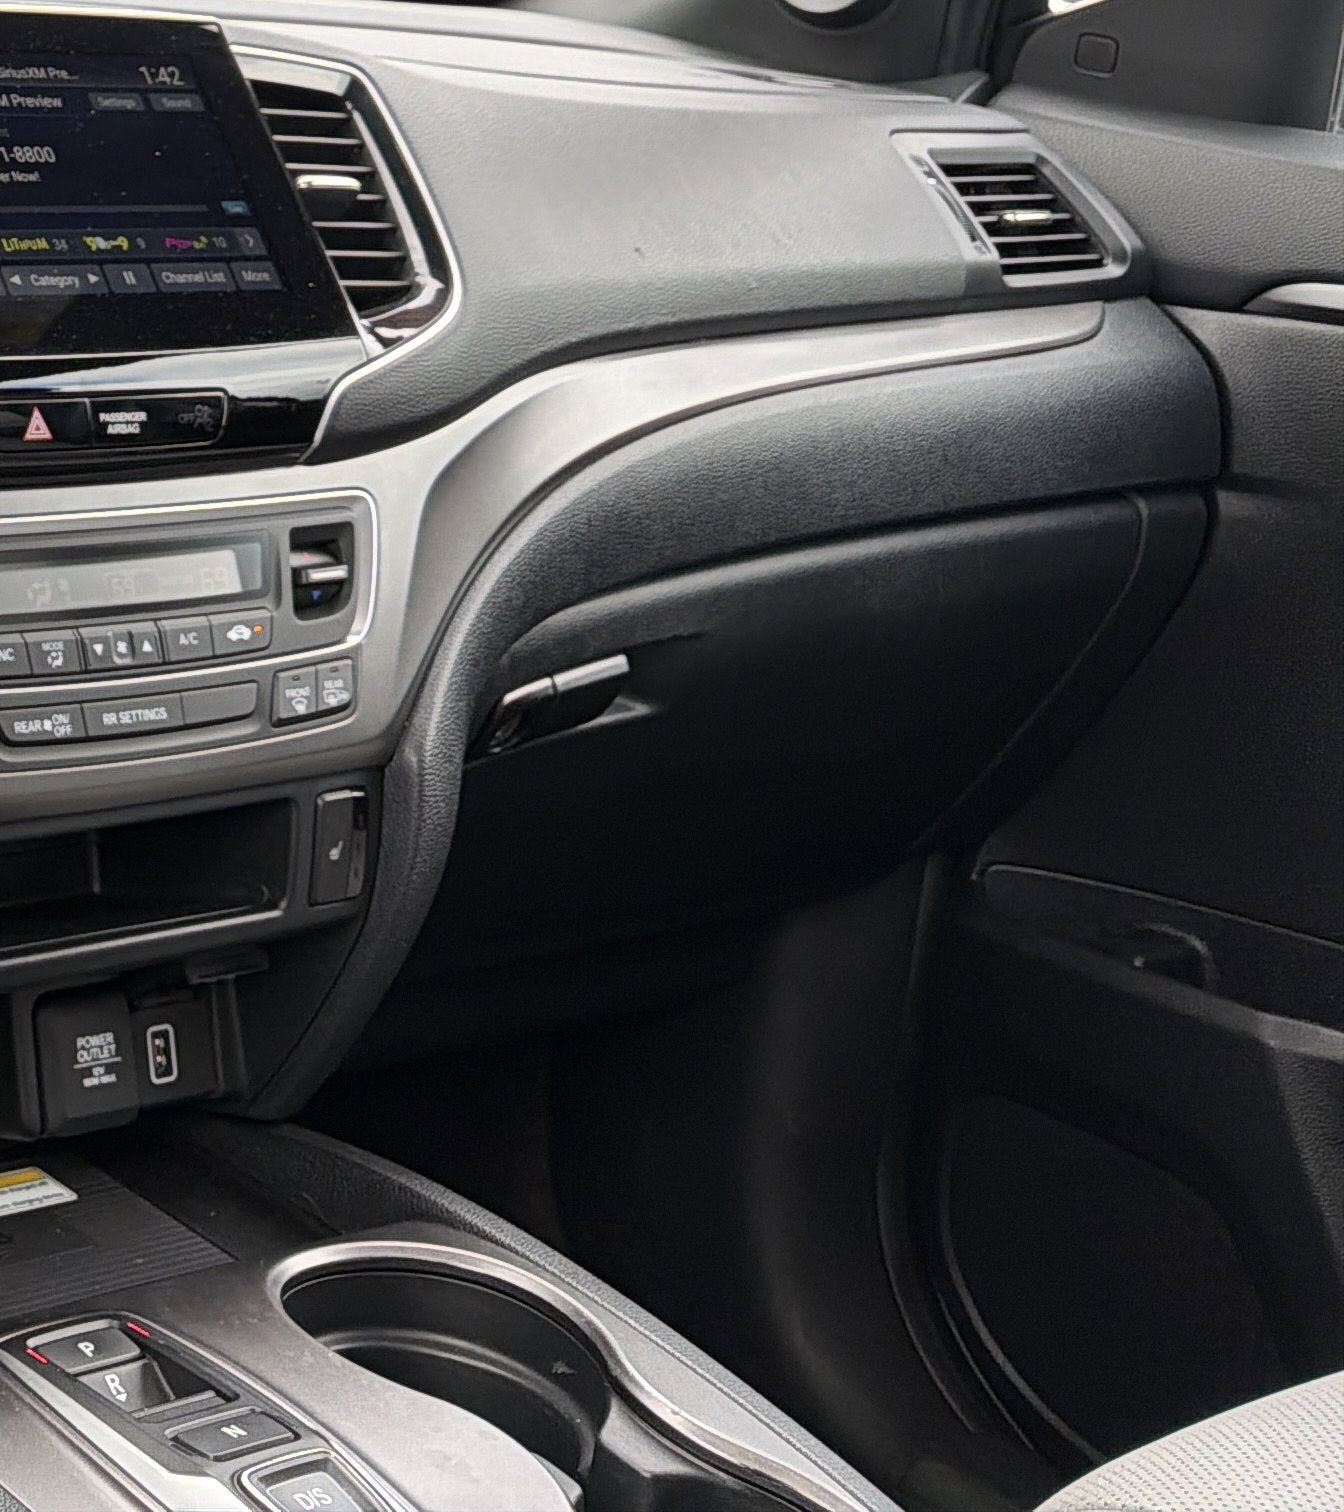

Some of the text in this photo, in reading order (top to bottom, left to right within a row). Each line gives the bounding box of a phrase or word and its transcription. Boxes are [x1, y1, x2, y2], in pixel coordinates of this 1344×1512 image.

[138, 65, 185, 86] 1:42
[10, 92, 63, 109] Preview
[96, 96, 137, 110] Settings
[11, 171, 41, 183] Now!
[29, 273, 79, 288] Category
[161, 270, 226, 284] Channel List
[241, 269, 270, 282] More
[98, 411, 148, 423] PASSENGER
[106, 422, 141, 435] AIRBAG
[41, 640, 64, 651] MODE
[178, 631, 199, 647] A/C
[51, 712, 70, 725] ON/
[102, 707, 168, 726] RR SETTINGS
[13, 720, 42, 735] REAR
[53, 724, 73, 738] OFF
[76, 1031, 115, 1050] POWER
[76, 1043, 116, 1063] OUTLET
[77, 1341, 95, 1357] P
[104, 1373, 125, 1395] R
[220, 1424, 248, 1439] N
[292, 1487, 333, 1511] D/S
